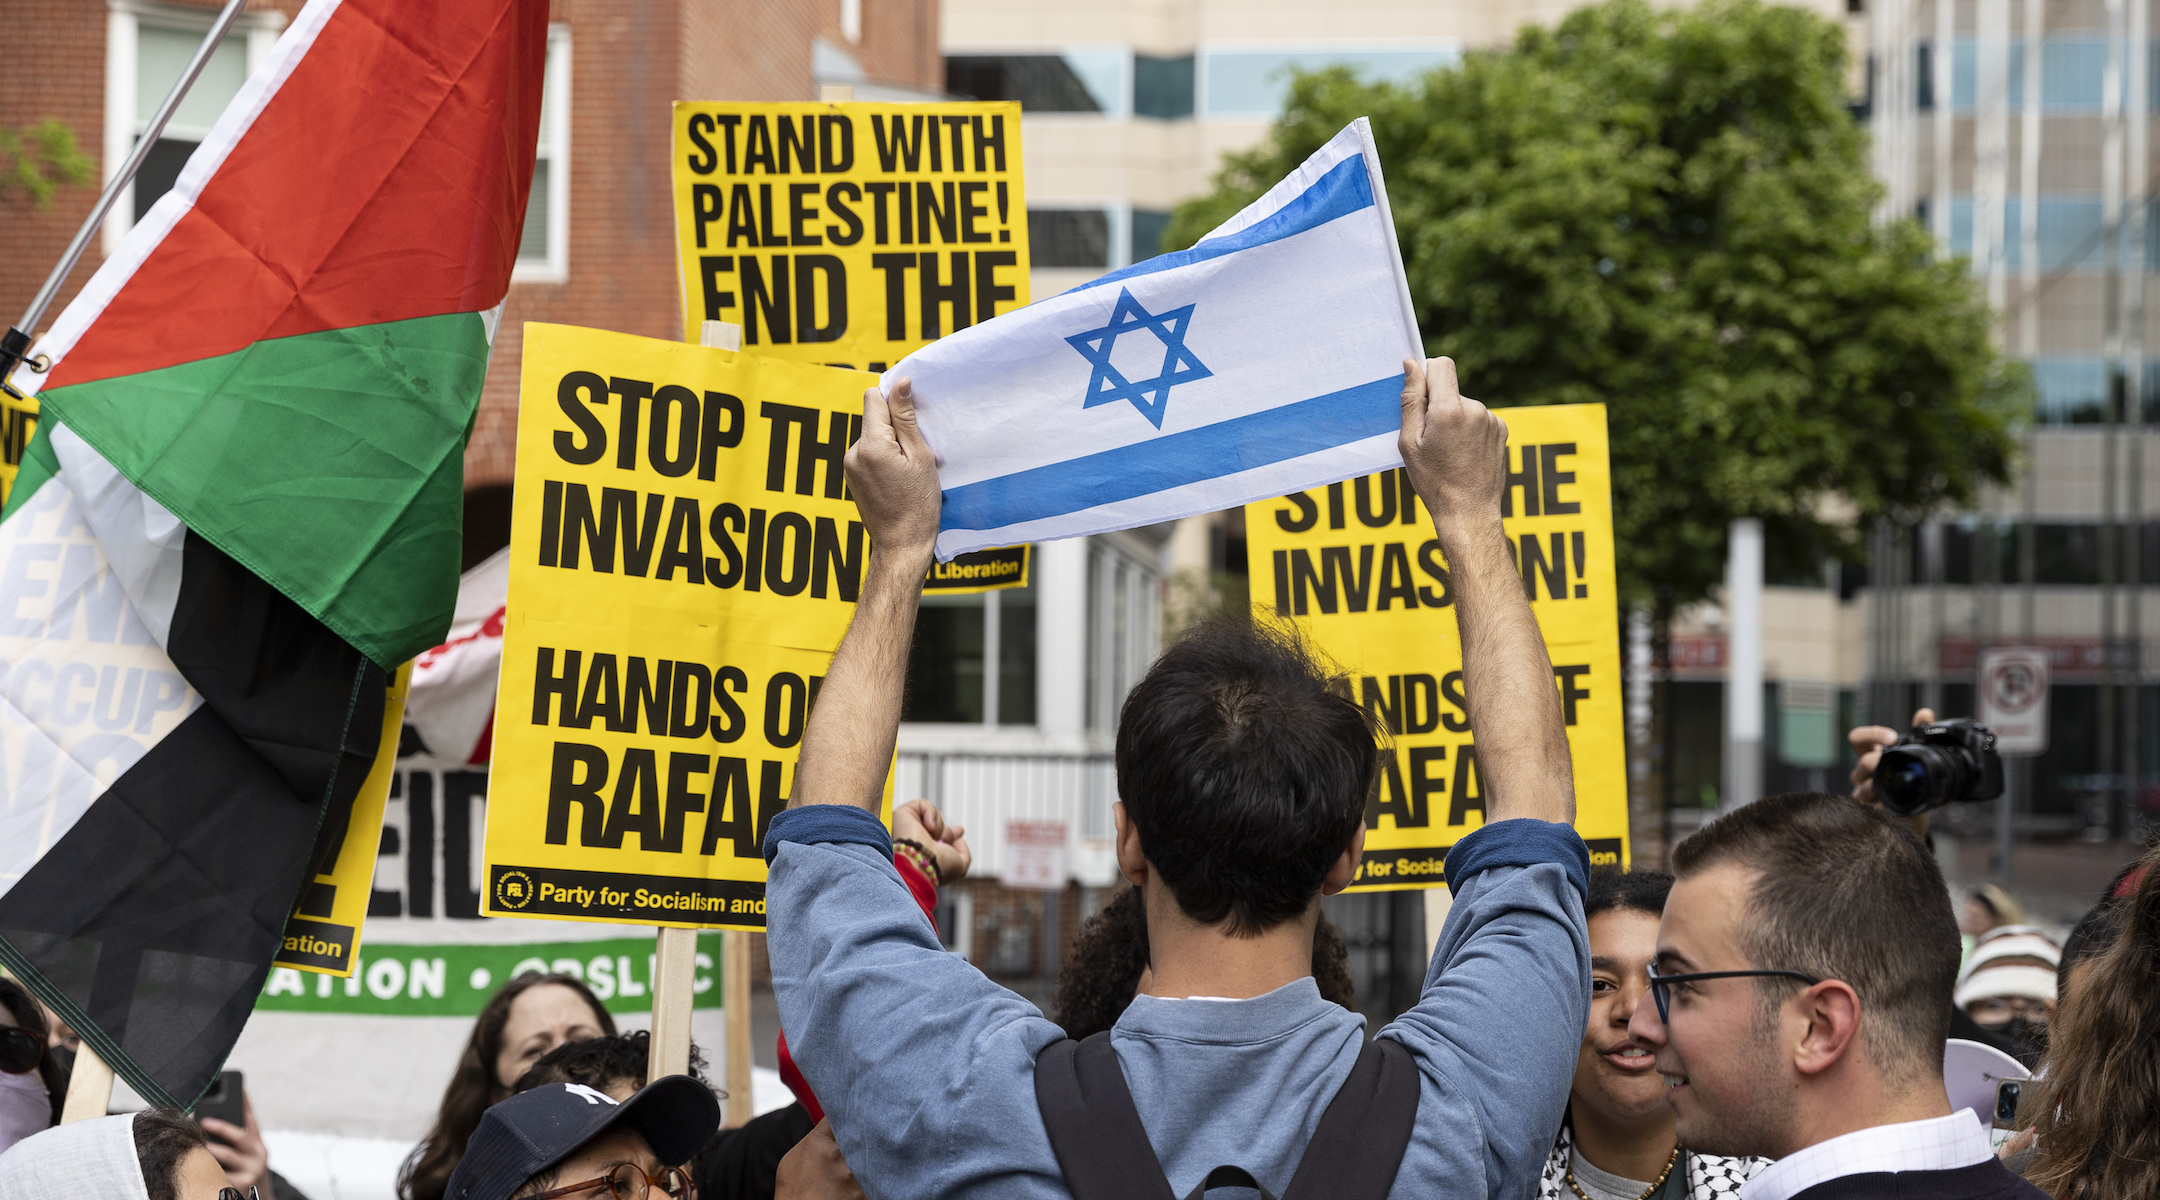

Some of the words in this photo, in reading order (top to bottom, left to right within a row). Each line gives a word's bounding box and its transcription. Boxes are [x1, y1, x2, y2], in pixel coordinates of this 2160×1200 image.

[688, 113, 854, 175] STAND
[871, 113, 1006, 173] WITH
[692, 181, 1011, 248] PALESTINE!
[700, 254, 848, 345] END
[553, 370, 745, 482] STOP
[1502, 442, 1581, 519] HE
[539, 479, 872, 603] INVASION
[934, 559, 1019, 580] Liberation
[1273, 531, 1588, 617] INVASN!
[531, 646, 748, 744] HANDS
[539, 882, 596, 908] Party
[599, 886, 630, 907] for
[633, 888, 726, 912] Socialism
[730, 897, 767, 915] and
[1366, 861, 1394, 877] for
[283, 935, 342, 958] ation
